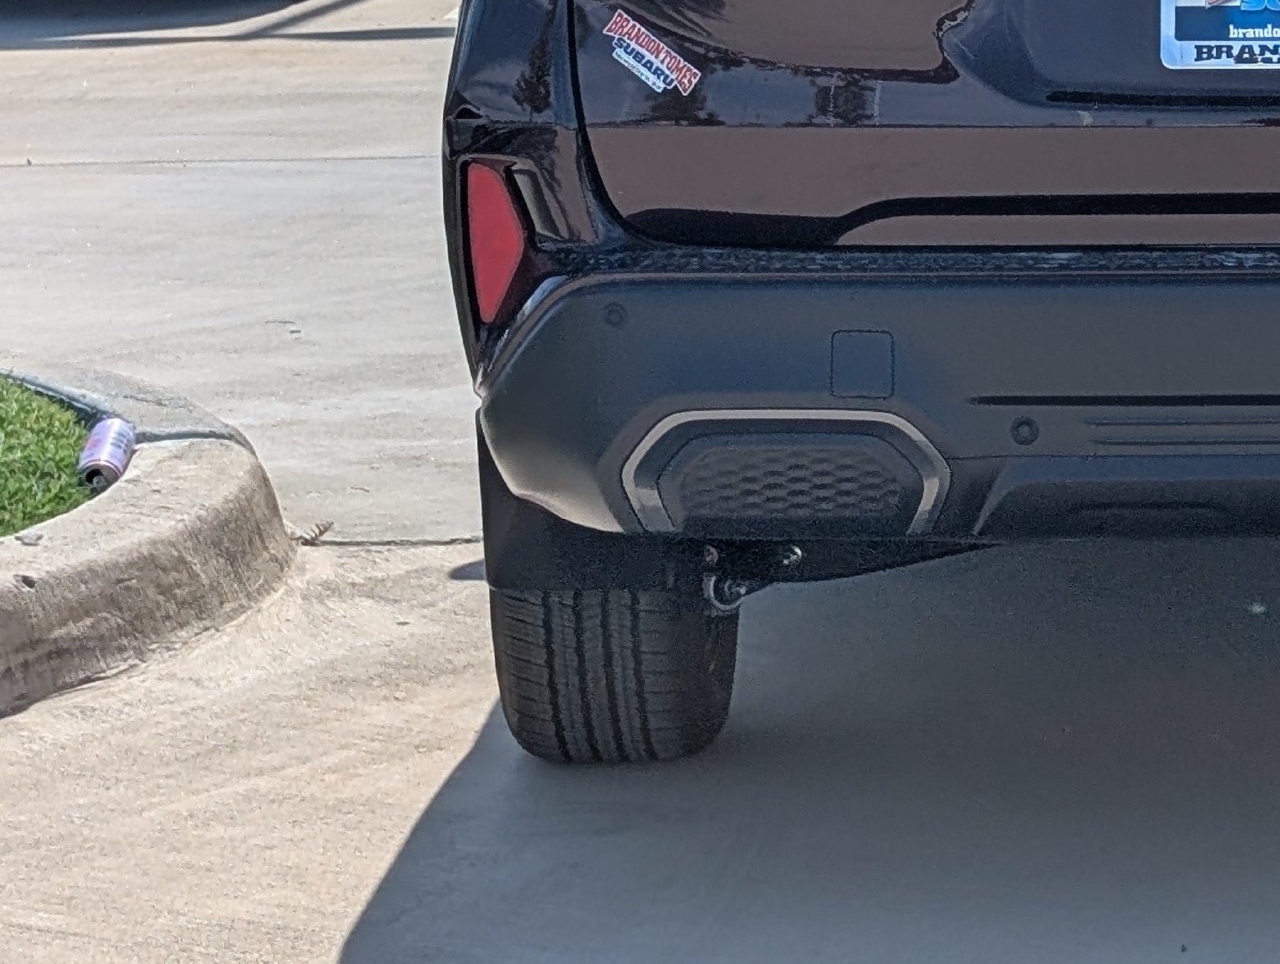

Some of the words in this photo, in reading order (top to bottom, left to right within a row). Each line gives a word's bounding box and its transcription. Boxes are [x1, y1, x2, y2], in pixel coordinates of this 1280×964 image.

[604, 10, 665, 60] BRANDON
[659, 48, 700, 95] TOMES
[614, 36, 676, 88] SUBARU
